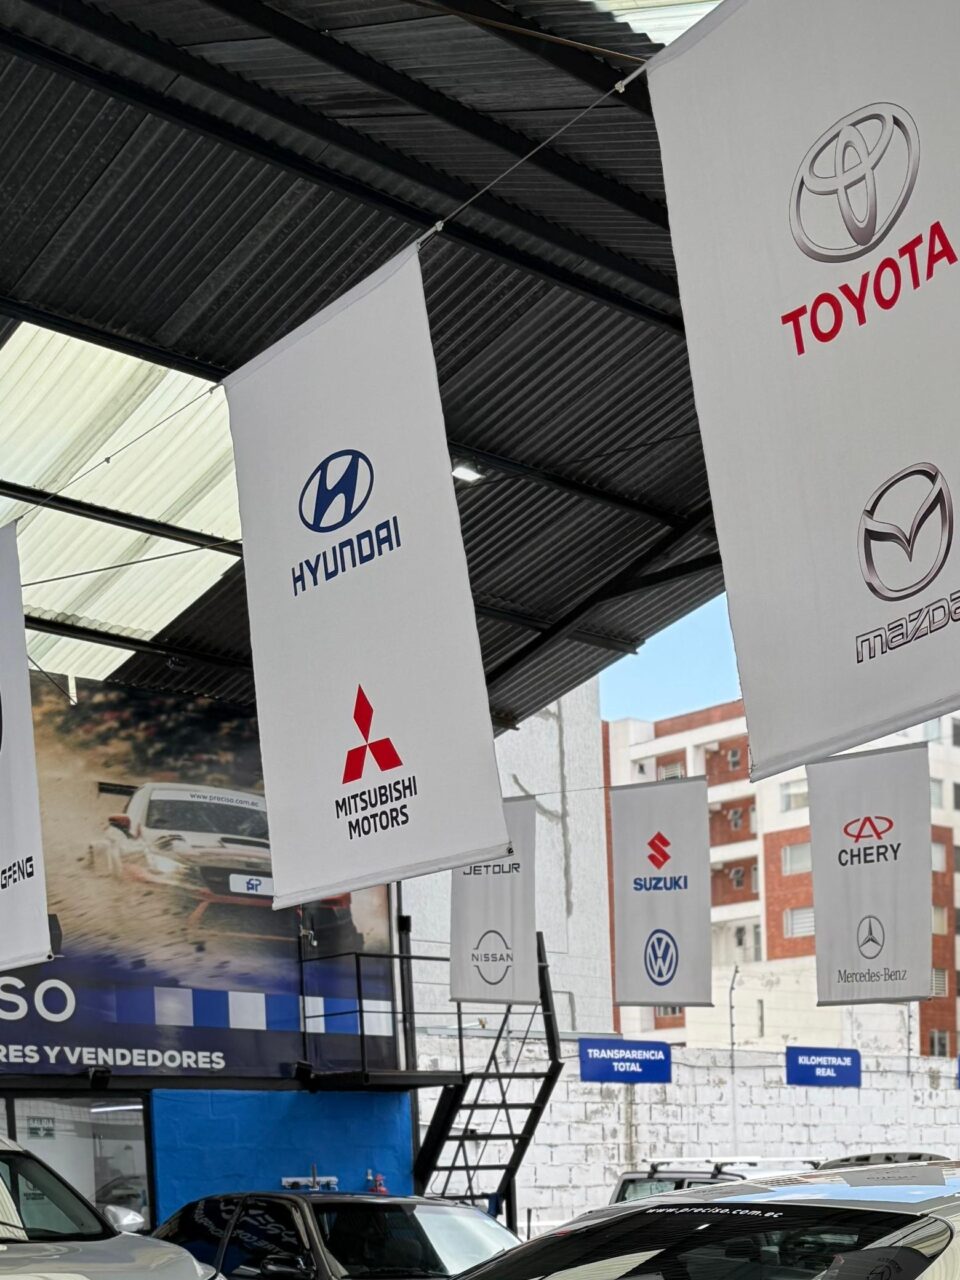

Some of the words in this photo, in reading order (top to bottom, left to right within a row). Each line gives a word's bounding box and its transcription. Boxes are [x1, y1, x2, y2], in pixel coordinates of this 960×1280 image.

[781, 221, 958, 356] TOYOTA
[291, 516, 402, 597] HYUNDAI
[335, 776, 418, 819] MITSUBISHI
[348, 805, 409, 840] MOTORS
[838, 843, 901, 867] CHERY
[463, 863, 521, 876] JETOUR
[633, 875, 688, 892] SUZUKI
[472, 953, 514, 962] NISSAN
[837, 967, 907, 983] Mercedes-Benz
[43, 1046, 61, 1064] Y
[63, 1047, 226, 1069] VENDEDORES
[587, 1048, 665, 1060] TRANSPARENCIA
[798, 1055, 852, 1066] KILOMETRAJE
[612, 1061, 643, 1072] TOTAL
[815, 1067, 837, 1077] REAL
[646, 1201, 783, 1218] www.preciso.com.ec
